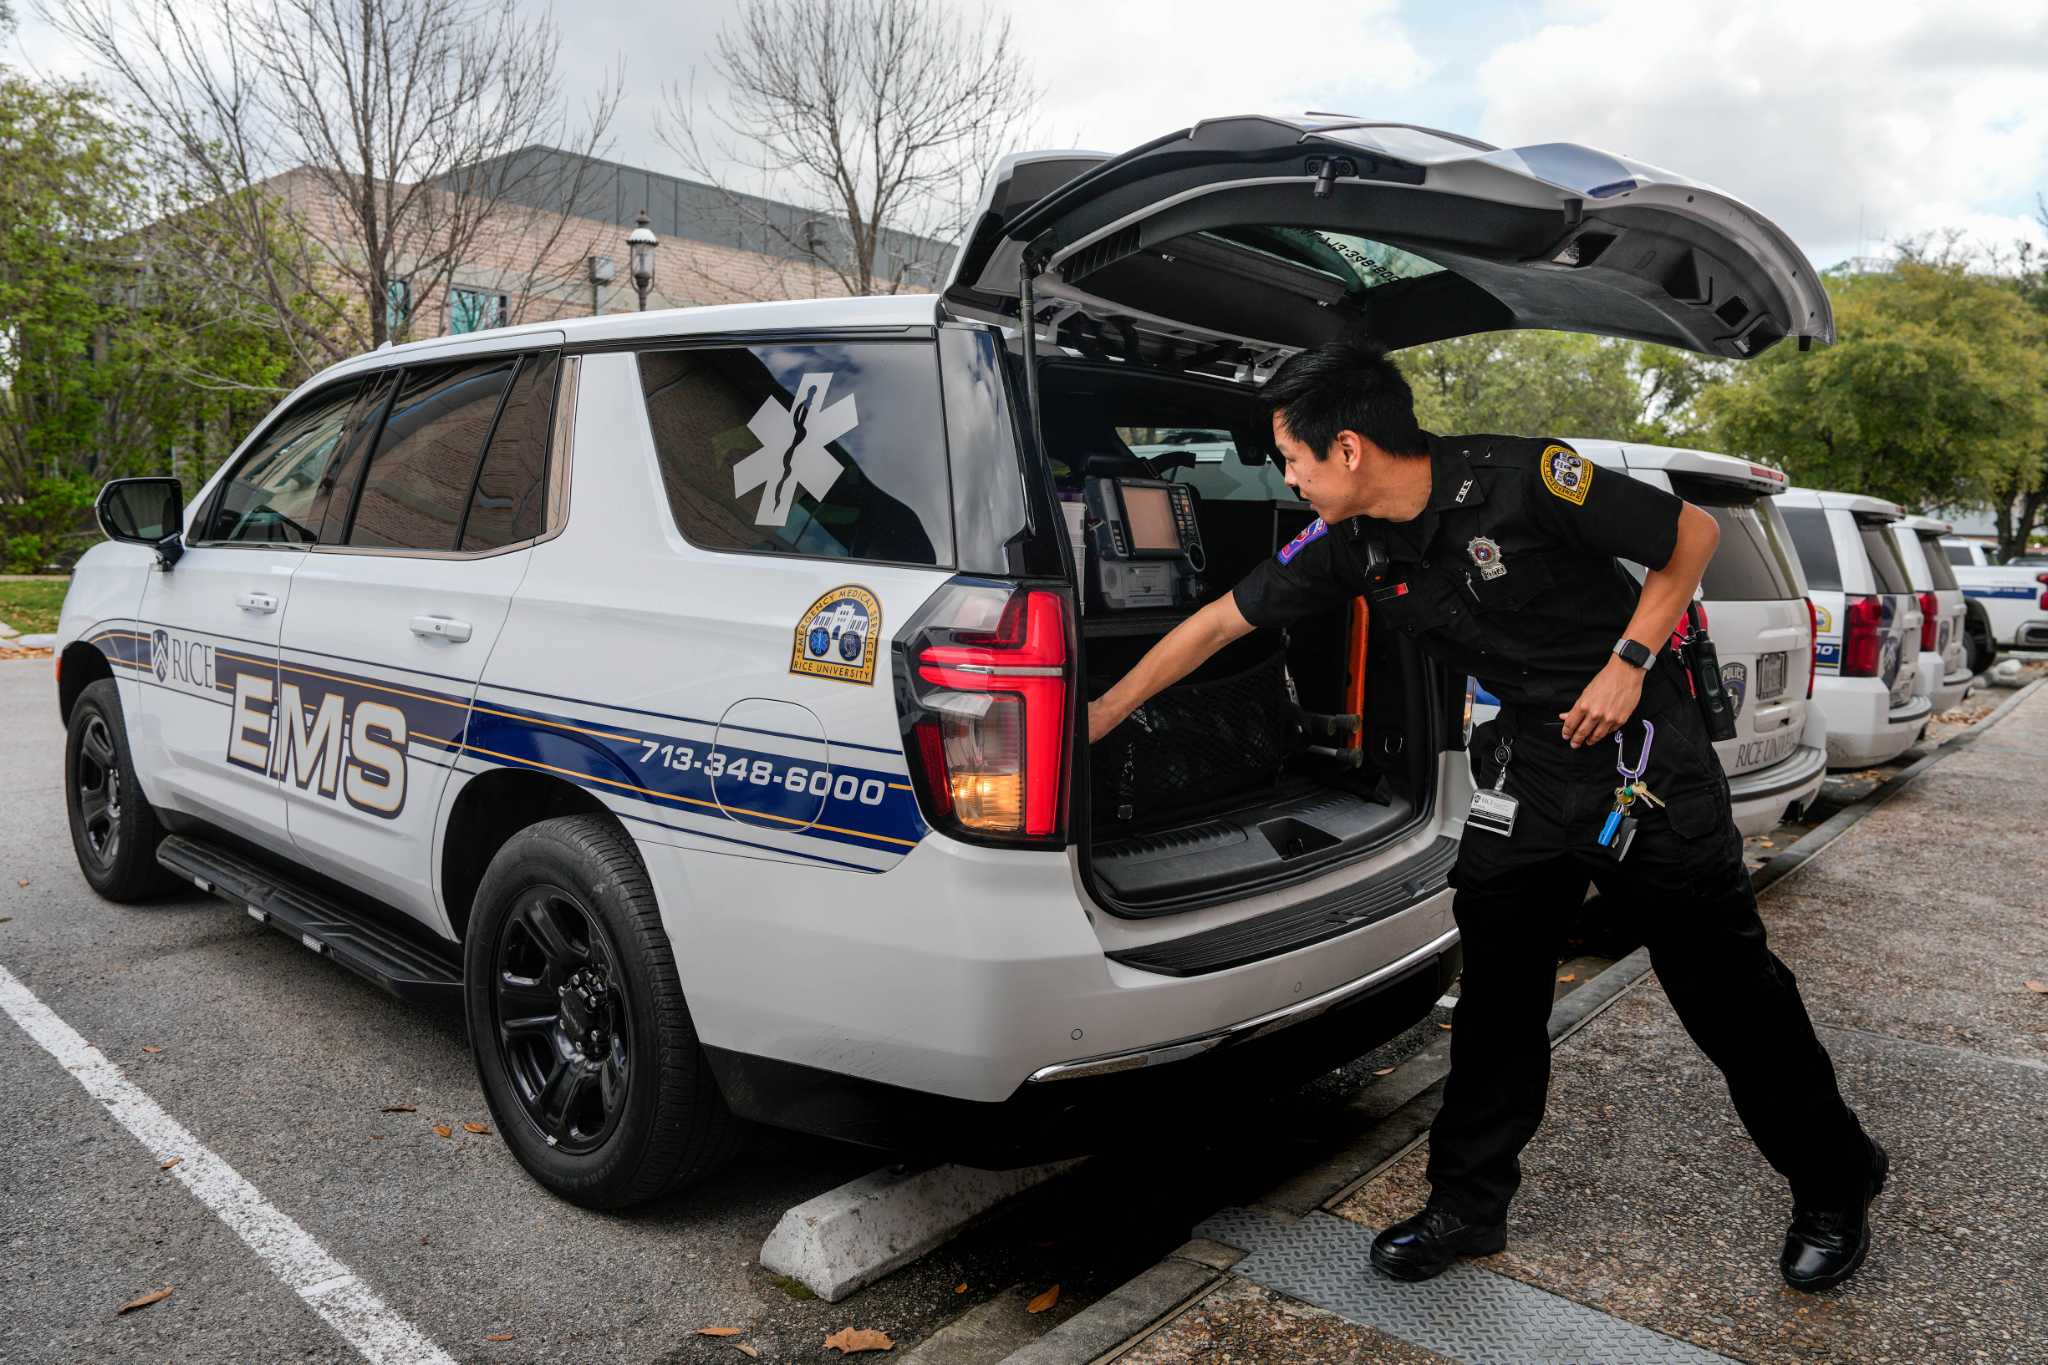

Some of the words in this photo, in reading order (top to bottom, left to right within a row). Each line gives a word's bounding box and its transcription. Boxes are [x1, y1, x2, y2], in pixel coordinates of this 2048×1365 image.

[797, 593, 837, 653] EMERGENCY
[840, 590, 874, 608] MEDICAL
[866, 610, 878, 662] SERVICES
[172, 638, 213, 689] RICE
[793, 661, 813, 672] RICE
[816, 666, 870, 679] UNIVERSITY
[1722, 666, 1745, 681] POLICE
[227, 672, 408, 820] EMS
[1736, 741, 1764, 767] RICE
[639, 740, 885, 806] 713-348-6000
